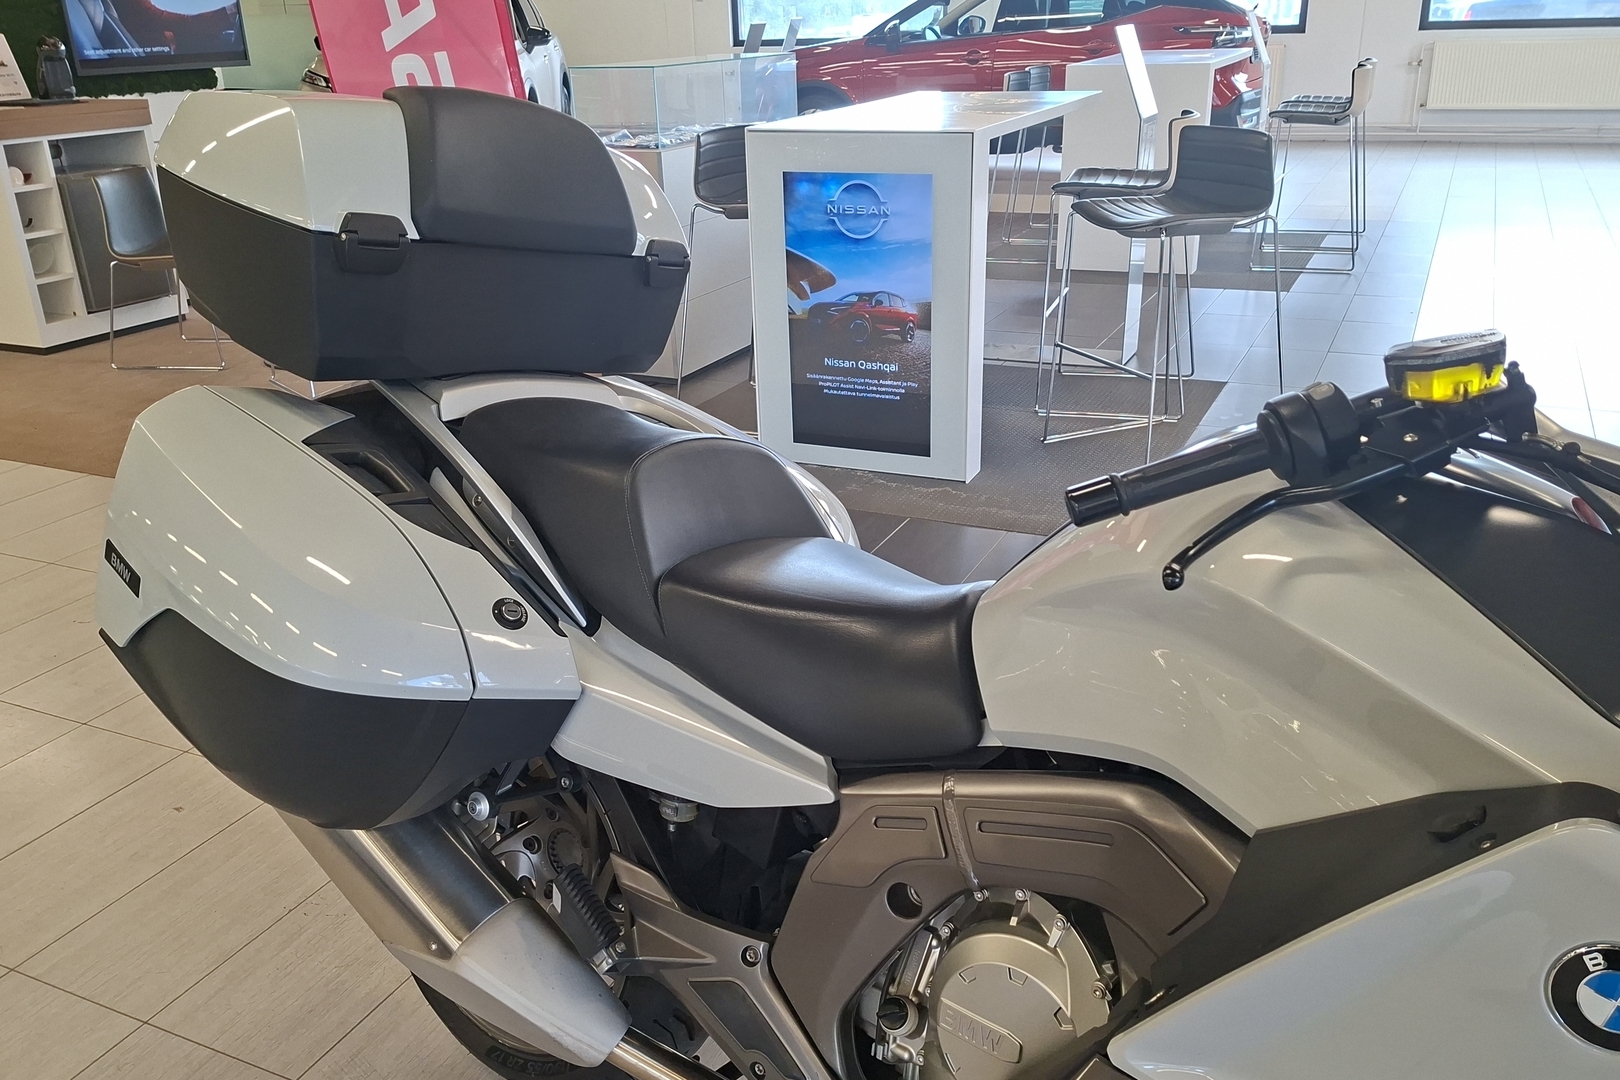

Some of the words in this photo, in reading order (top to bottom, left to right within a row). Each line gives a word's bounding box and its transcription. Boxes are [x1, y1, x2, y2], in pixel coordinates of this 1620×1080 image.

[827, 204, 891, 215] NISSAN
[824, 358, 856, 368] Nissan
[858, 361, 899, 373] Qashqai
[823, 388, 856, 396] Mukautettava
[110, 552, 131, 583] BMW
[940, 1009, 1002, 1055] BMW
